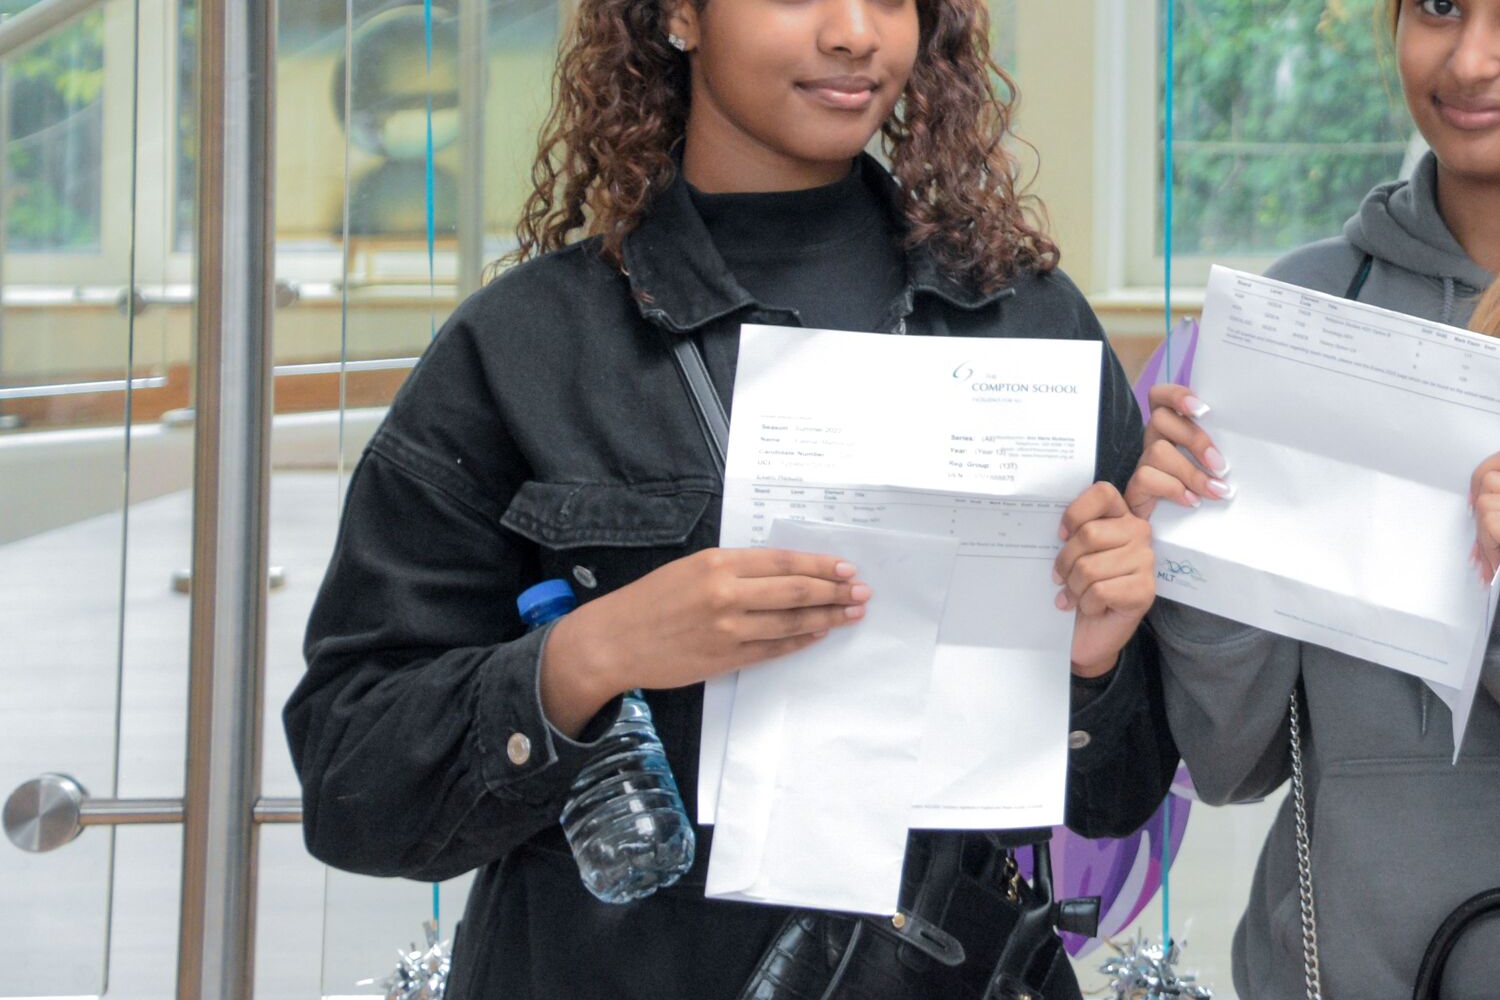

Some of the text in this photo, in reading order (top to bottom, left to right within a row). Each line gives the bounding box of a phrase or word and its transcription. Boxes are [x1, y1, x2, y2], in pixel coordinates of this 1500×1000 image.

[971, 382, 1078, 394] COMPTON SCHOOL
[1156, 570, 1176, 583] MLT
